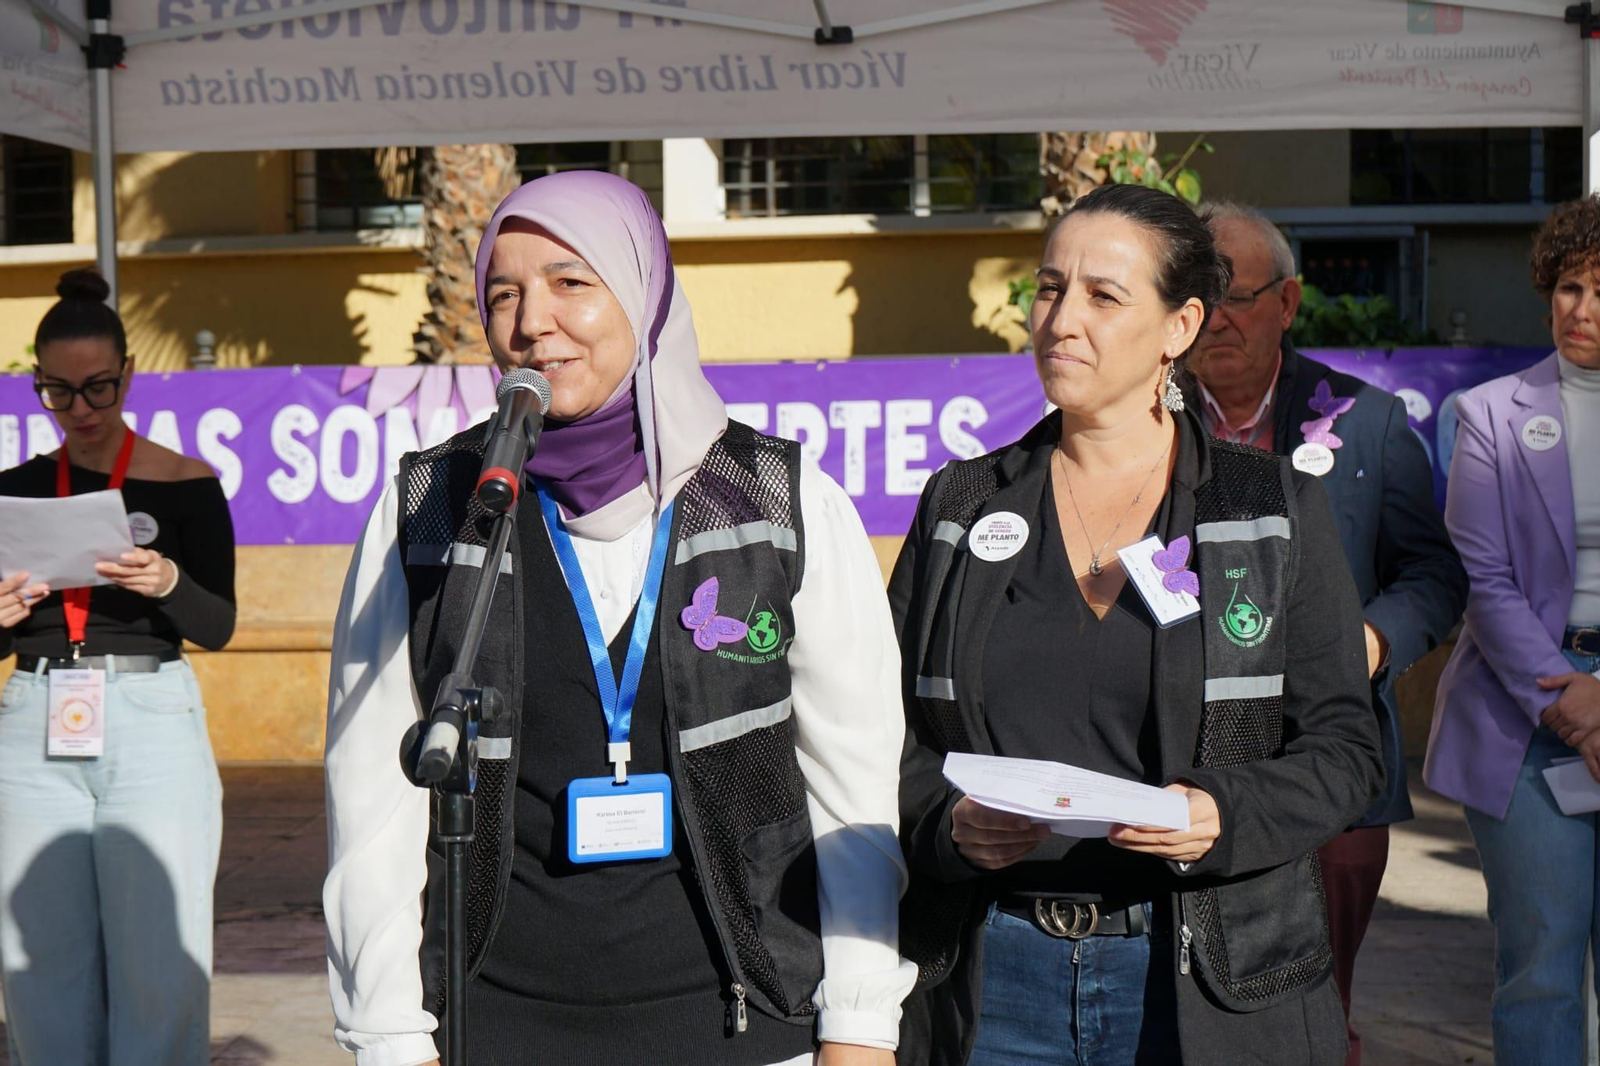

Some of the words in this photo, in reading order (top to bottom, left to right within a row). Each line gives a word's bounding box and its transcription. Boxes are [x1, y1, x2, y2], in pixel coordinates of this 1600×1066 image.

[1225, 568, 1247, 579] HSF
[716, 650, 766, 664] HUMANITARIOS
[766, 654, 776, 662] SIN
